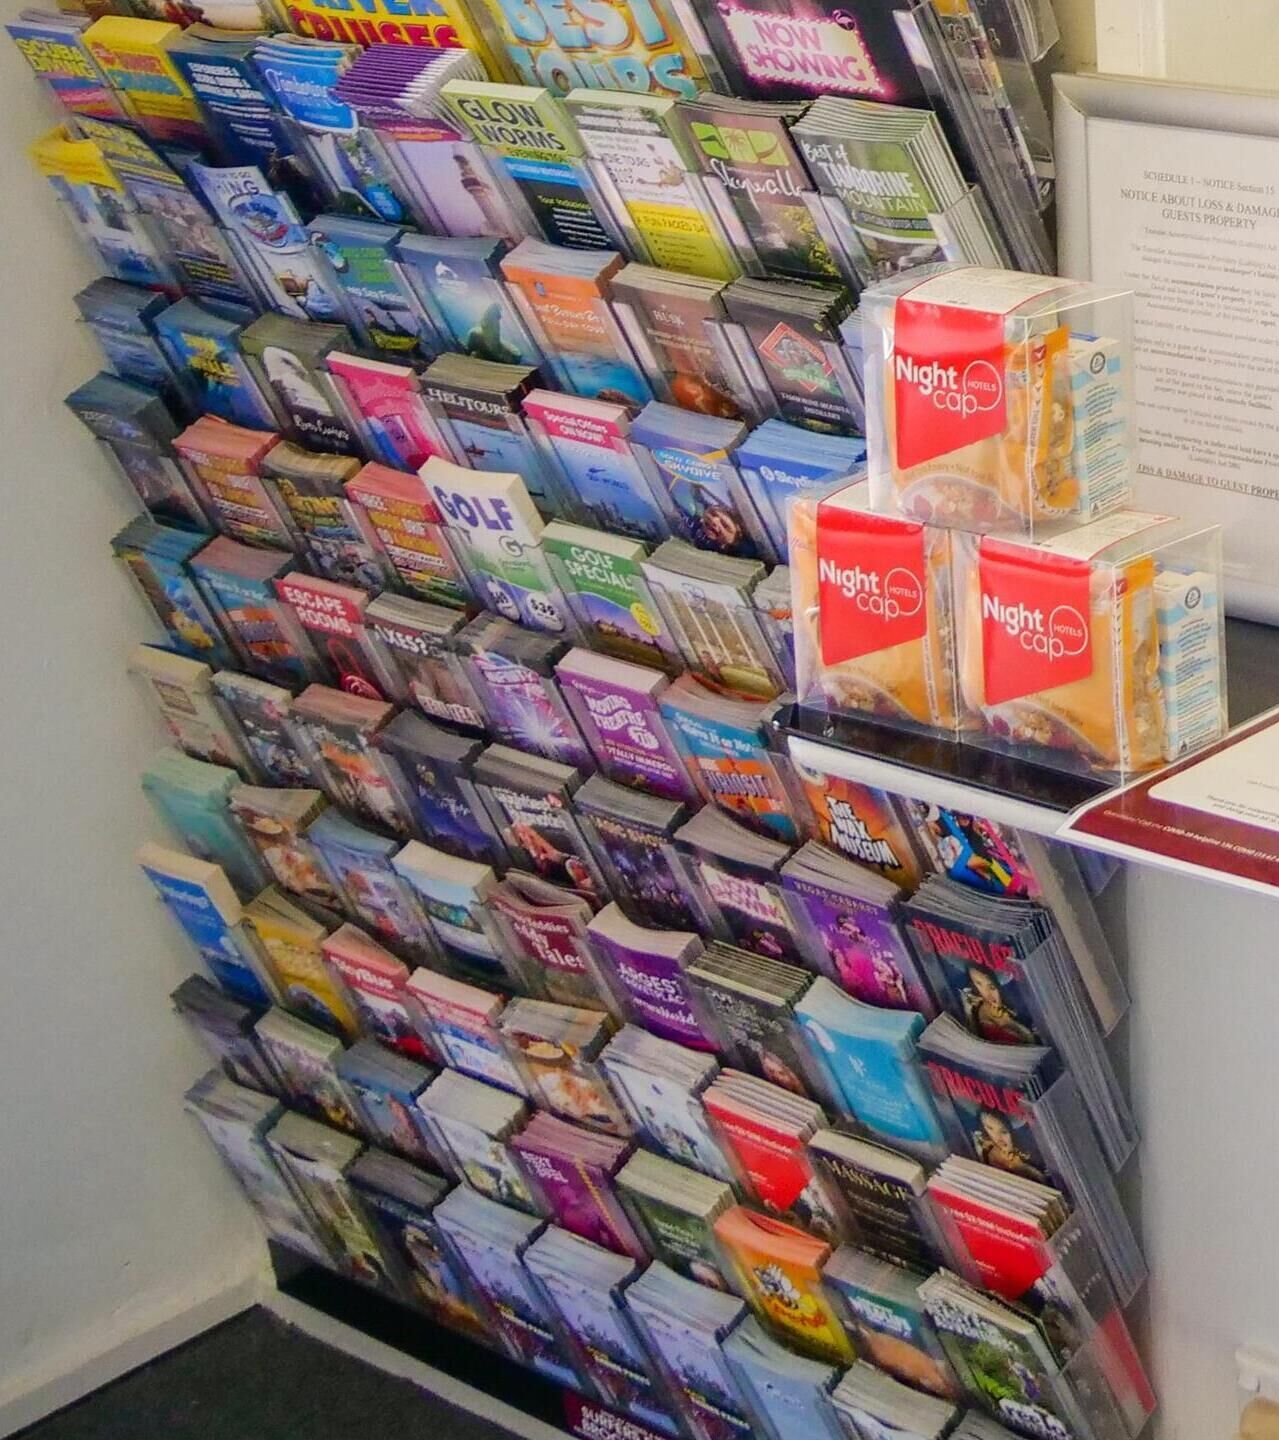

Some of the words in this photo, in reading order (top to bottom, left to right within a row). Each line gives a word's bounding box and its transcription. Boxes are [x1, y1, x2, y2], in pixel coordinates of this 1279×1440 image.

[755, 20, 823, 51] NOW
[746, 43, 869, 84] SHOWING
[458, 99, 544, 127] GLOW
[475, 124, 566, 151] WORMS
[819, 163, 920, 198] TAMBORINE
[1120, 188, 1159, 204] NOTICE
[1160, 195, 1197, 208] ABOUT
[1198, 199, 1224, 211] LOSS
[1225, 201, 1234, 212] &
[1161, 209, 1201, 225] GUESTS
[1203, 213, 1257, 230] PROPERTY
[895, 355, 958, 396] Night
[932, 388, 978, 419] cap
[967, 379, 997, 393] HOTELS
[433, 486, 514, 531] GOLF
[570, 547, 614, 568] GOLF
[283, 587, 347, 616] ESCAPE
[819, 559, 878, 598] Night
[856, 589, 900, 622] cap
[889, 585, 918, 599] HOTELS
[296, 607, 352, 634] ROOMS
[982, 592, 1042, 636] Night
[1019, 629, 1064, 661] cap
[1053, 625, 1083, 639] HOTELS
[832, 831, 903, 868] MUSEUM
